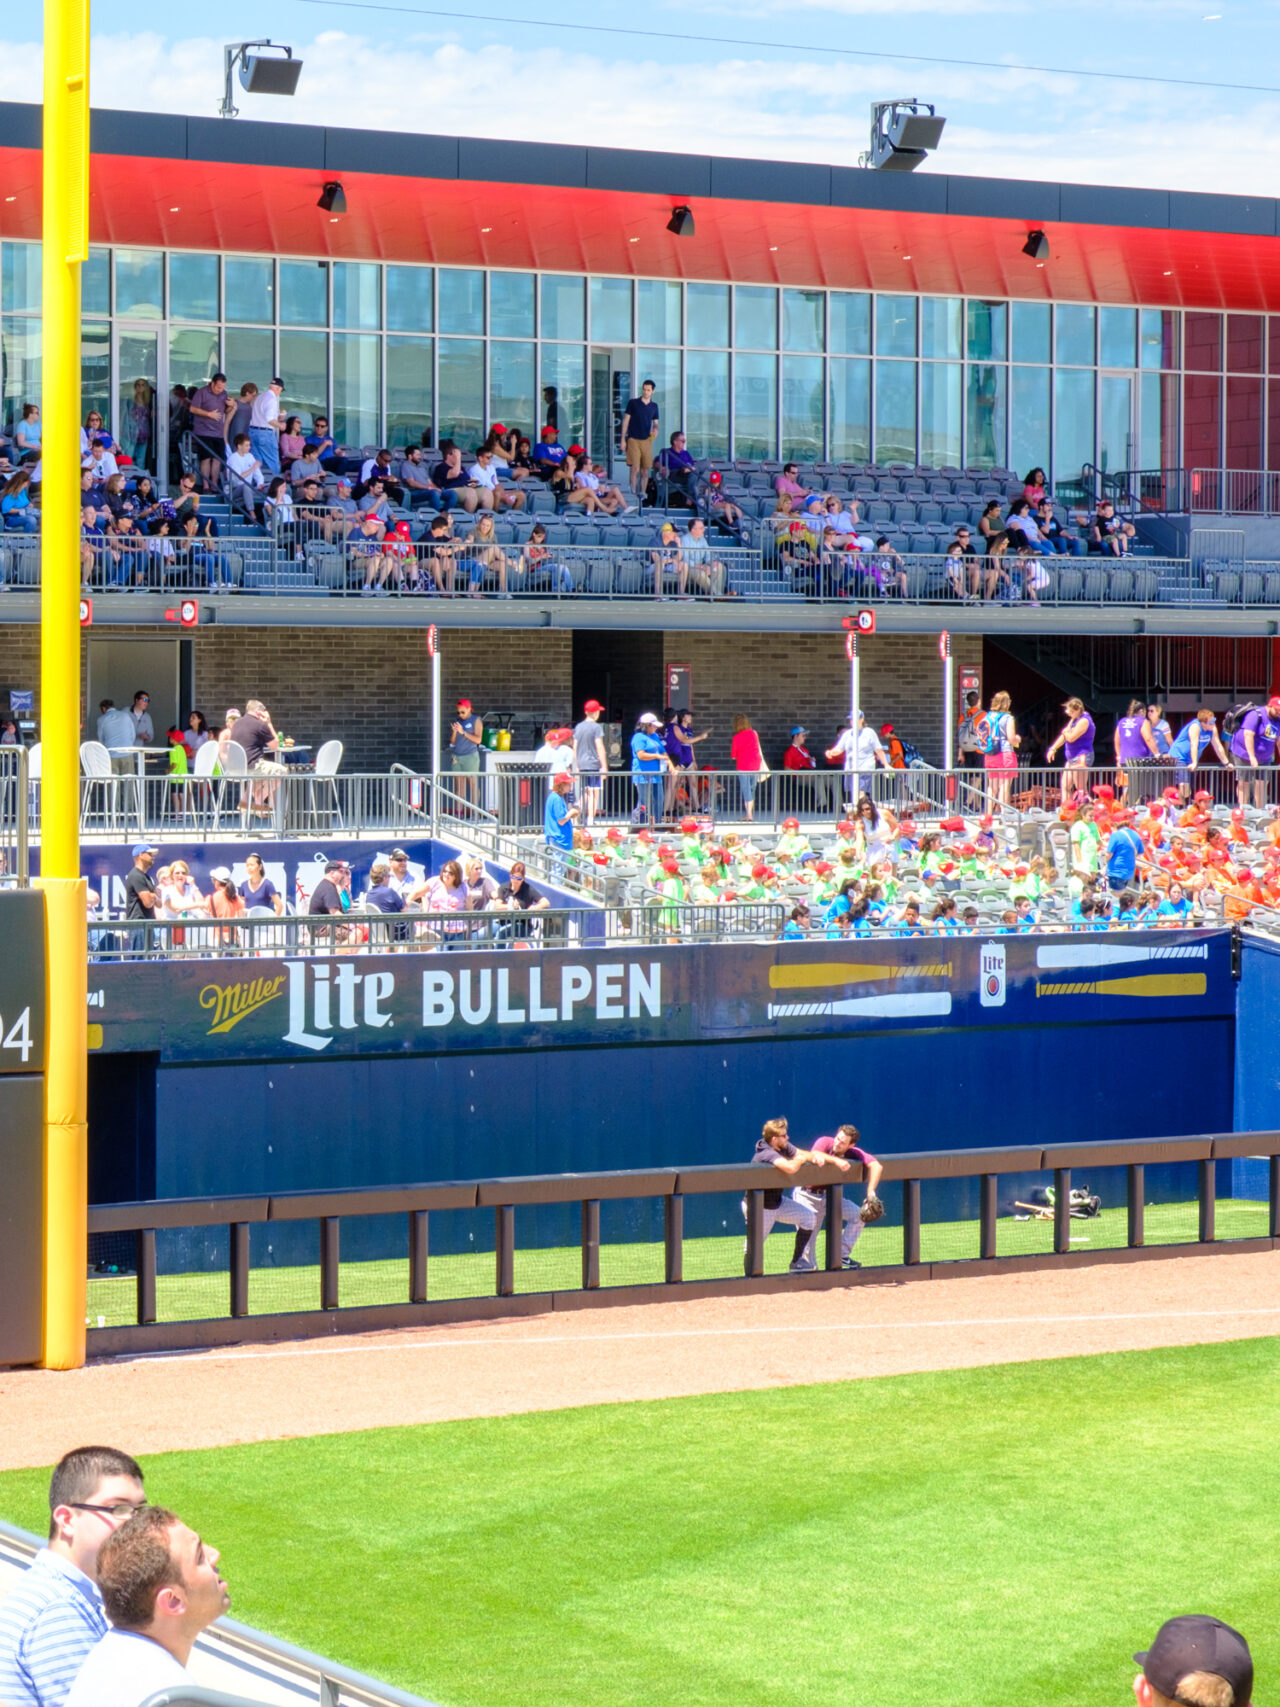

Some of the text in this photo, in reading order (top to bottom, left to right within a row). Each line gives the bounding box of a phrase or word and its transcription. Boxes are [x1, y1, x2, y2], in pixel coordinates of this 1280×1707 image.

[983, 955, 1004, 974] Lite
[199, 961, 661, 1050] Miller Lite BULLPEN
